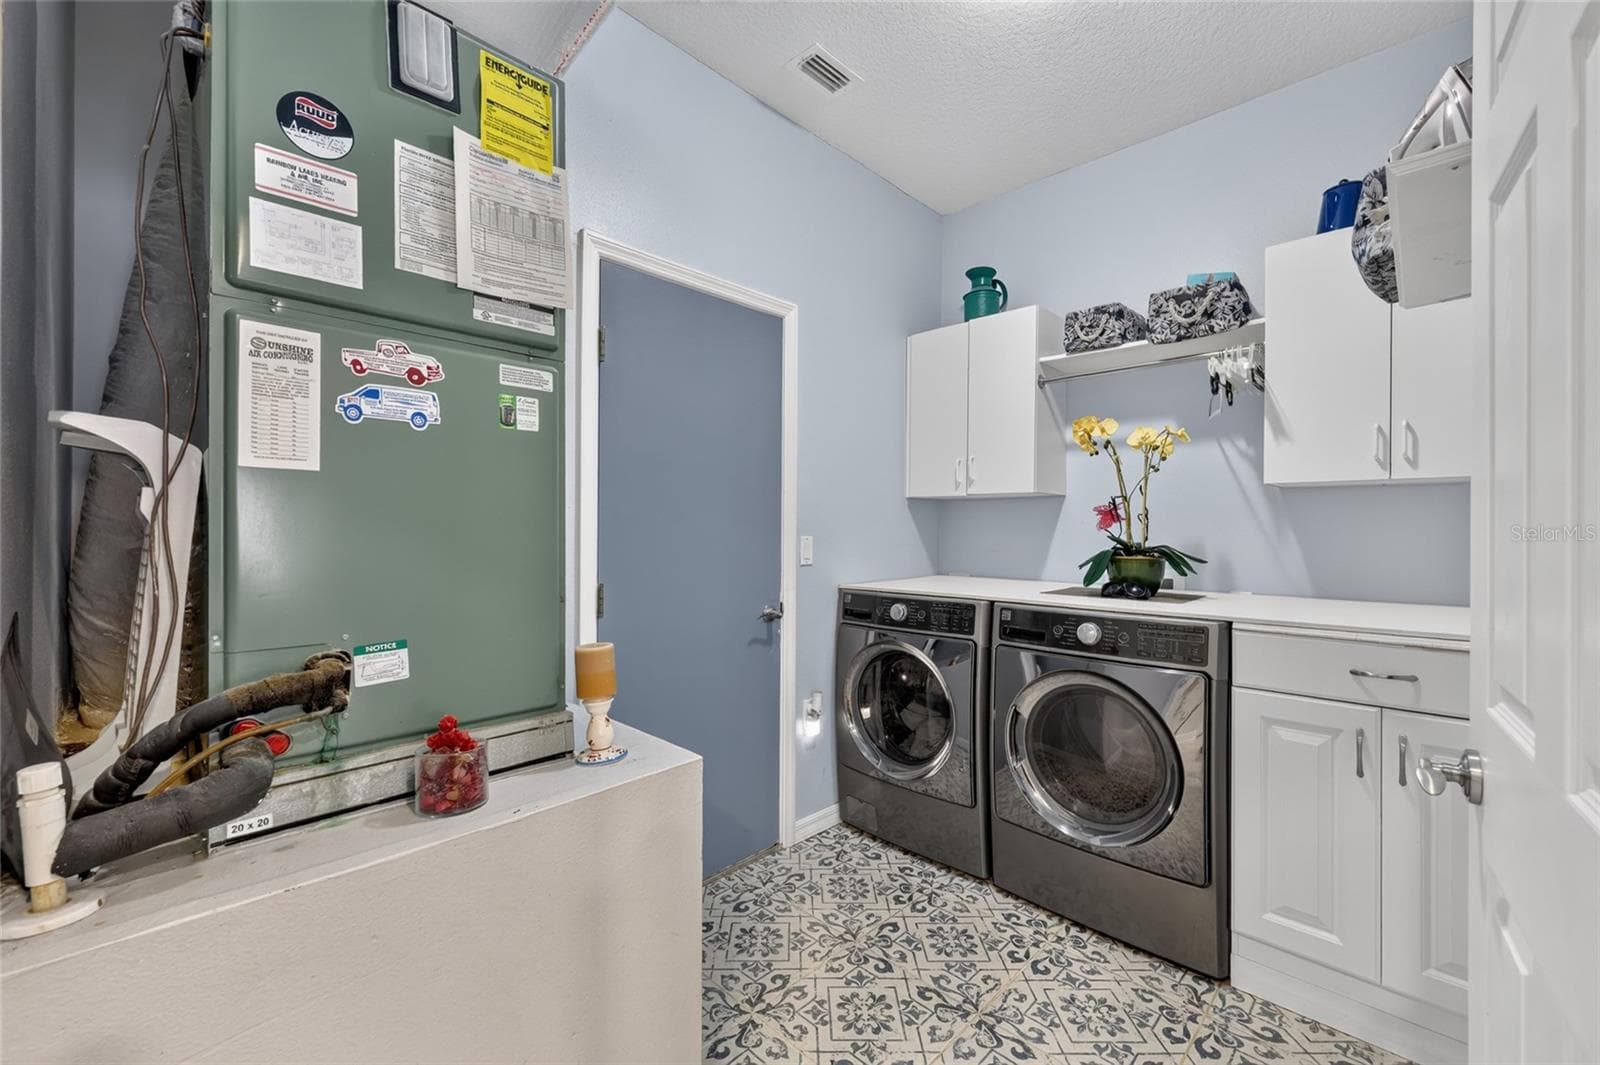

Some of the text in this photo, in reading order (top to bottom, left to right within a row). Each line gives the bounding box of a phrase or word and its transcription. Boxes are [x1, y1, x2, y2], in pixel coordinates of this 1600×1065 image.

[296, 102, 336, 123] RUUD
[365, 642, 397, 653] NOTICE
[231, 824, 244, 834] 20
[257, 817, 270, 828] 20
